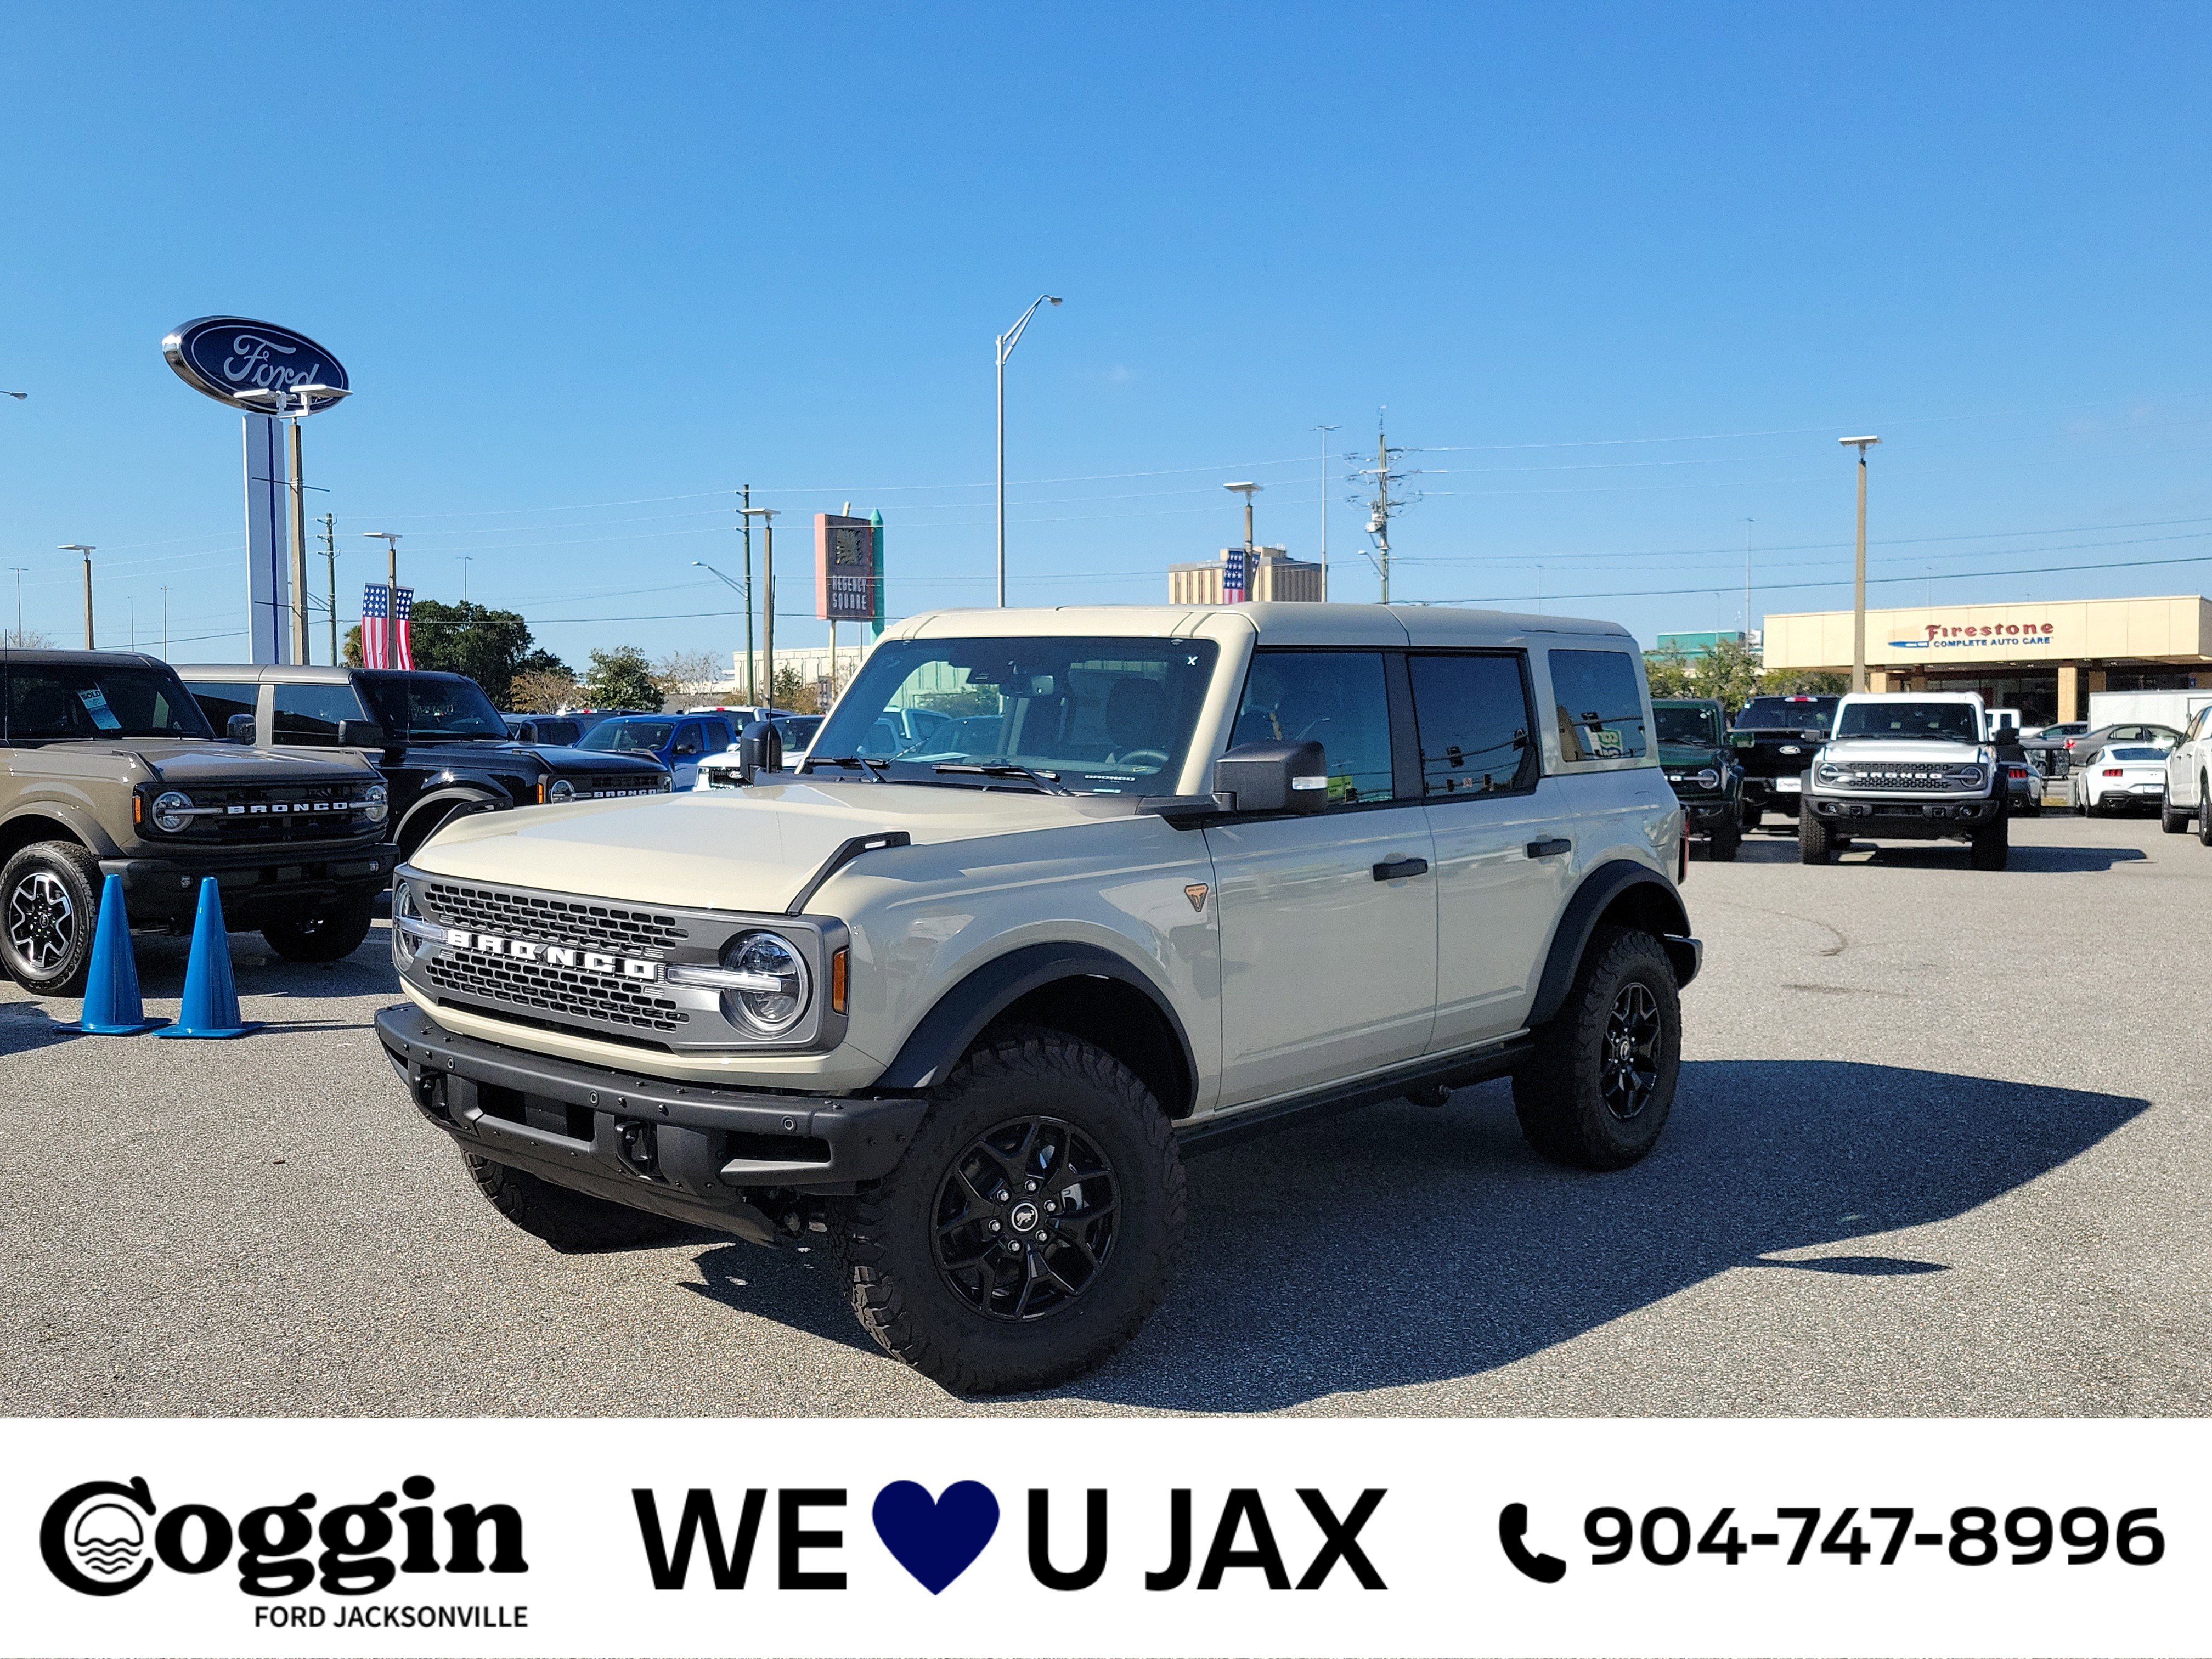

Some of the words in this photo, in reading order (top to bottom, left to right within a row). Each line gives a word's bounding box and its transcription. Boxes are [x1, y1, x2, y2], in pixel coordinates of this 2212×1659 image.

[224, 335, 319, 390] Ford
[832, 575, 867, 593] REGENCY
[832, 592, 867, 610] SQUARE
[1925, 623, 2054, 641] Firestone
[1933, 639, 1987, 647] COMPLETE
[2022, 636, 2051, 645] CARE
[81, 691, 101, 700] SOLD
[594, 789, 657, 798] BRONCO
[227, 802, 348, 814] BRONCO
[447, 929, 658, 980] BRONCO
